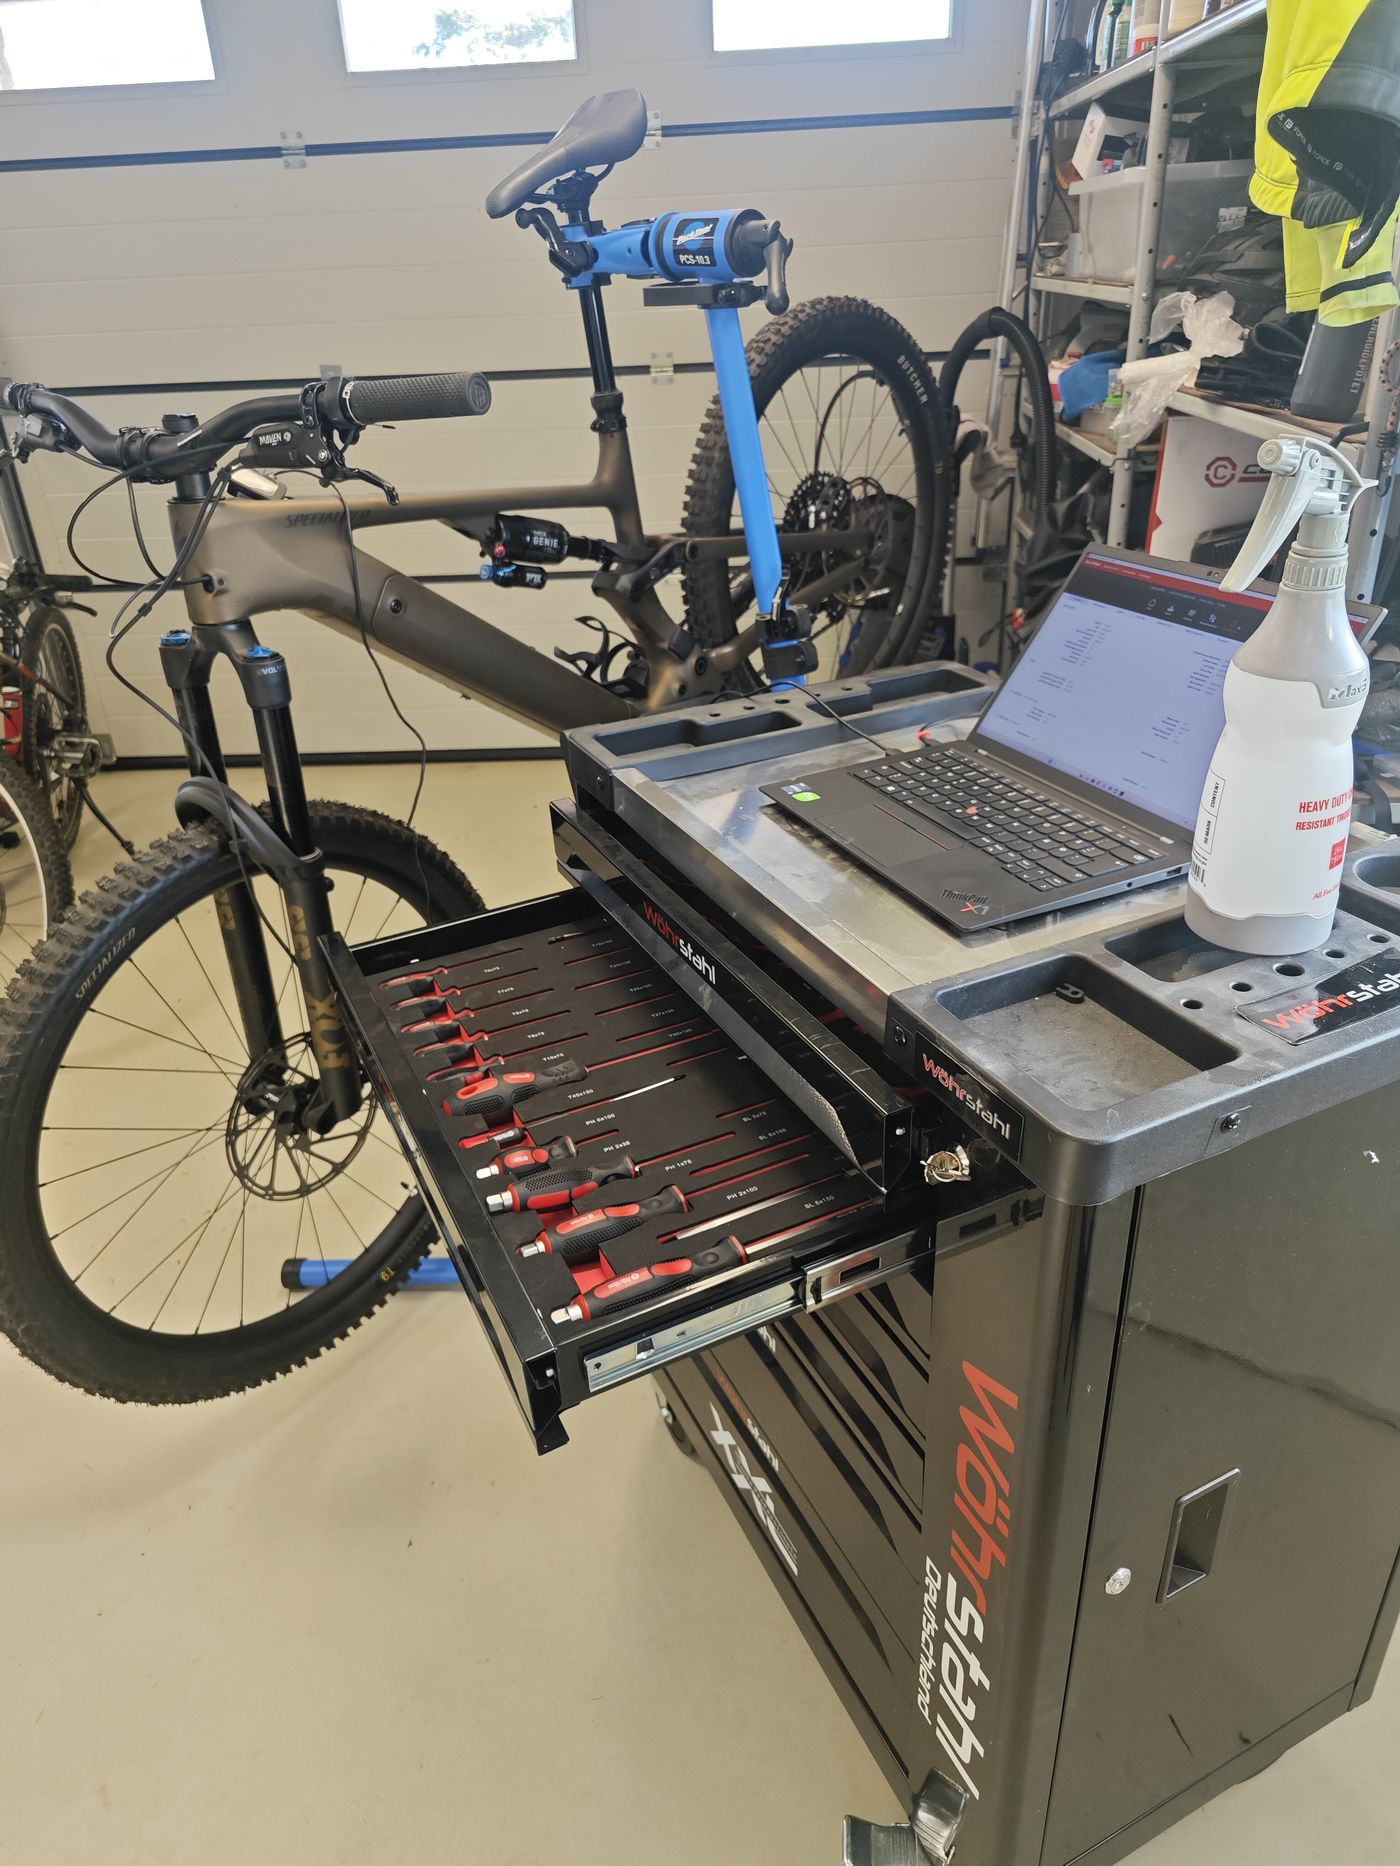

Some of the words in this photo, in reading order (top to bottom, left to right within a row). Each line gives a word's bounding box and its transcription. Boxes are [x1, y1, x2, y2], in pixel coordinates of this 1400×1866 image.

[678, 254, 711, 265] PCS-10.3
[897, 354, 929, 405] BUTCHER
[258, 432, 283, 446] MAVEN
[532, 536, 559, 549] GENIE
[1210, 782, 1220, 808] CONTENT
[1298, 798, 1330, 813] HEAVY
[1331, 791, 1348, 809] DUTY
[1295, 817, 1335, 831] RESISTANT
[1203, 820, 1212, 845] REMARK
[939, 888, 989, 904] ThinkPad
[75, 927, 136, 1000] SPECIALIZED
[585, 1118, 596, 1126] PH
[603, 1144, 615, 1153] PH
[664, 1164, 676, 1172] PH
[676, 1158, 693, 1168] 1x75
[726, 1192, 738, 1201] PH
[738, 1185, 759, 1197] 2x100
[917, 1554, 943, 1726] Deutschland
